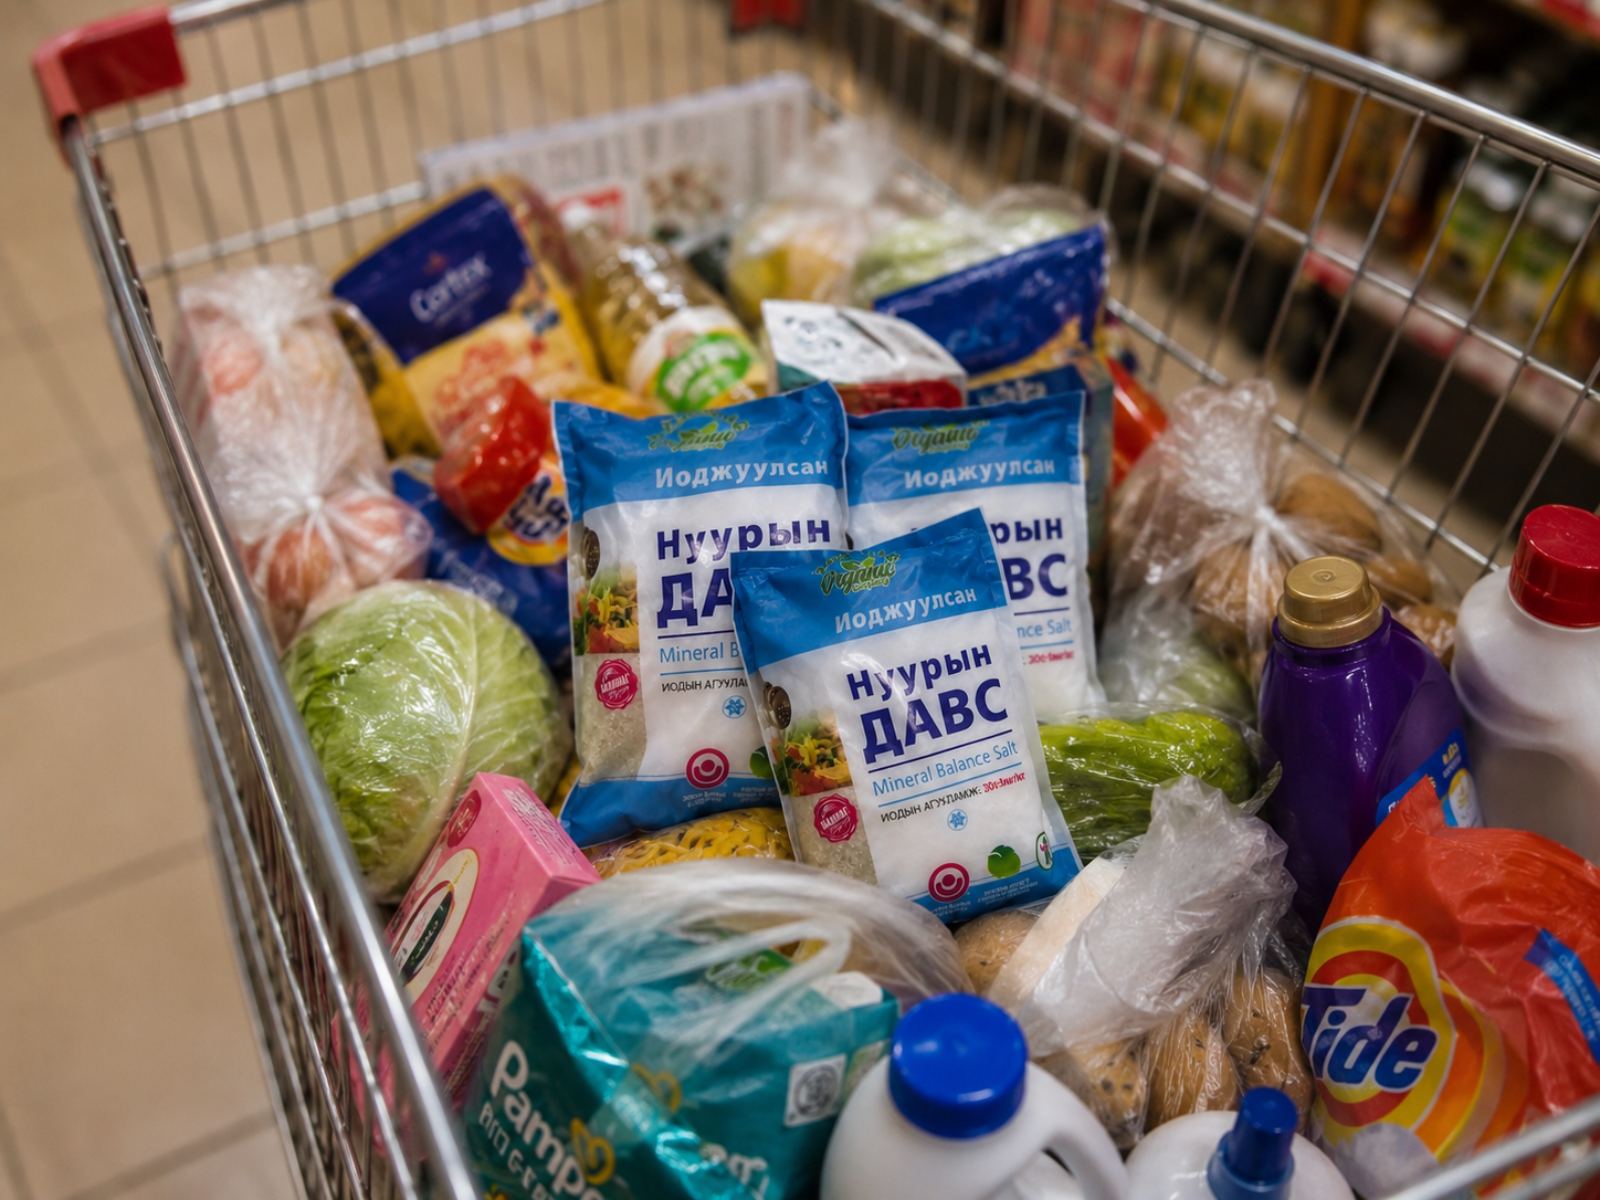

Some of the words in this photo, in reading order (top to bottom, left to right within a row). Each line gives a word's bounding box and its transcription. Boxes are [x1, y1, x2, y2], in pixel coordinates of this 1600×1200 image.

[656, 460, 828, 489] Иоджуулсан
[903, 458, 1055, 489] Иоджуулсан
[657, 520, 831, 565] Нуурын
[990, 518, 1063, 544] рын
[657, 568, 734, 629] ДА
[1001, 553, 1068, 601] ВС
[835, 588, 977, 634] Иоджуулсан
[1047, 618, 1072, 635] Salt
[660, 642, 724, 664] Mineral
[847, 645, 992, 702] Нуурын
[662, 679, 702, 693] ИОДЫН
[705, 678, 748, 691] АГУУЛА
[860, 678, 1008, 765] ДАВС
[872, 767, 933, 797] Mineral
[936, 753, 990, 778] Balance
[995, 740, 1018, 760] Salt
[880, 804, 921, 823] ИОДЫН
[1302, 985, 1438, 1092] Tide
